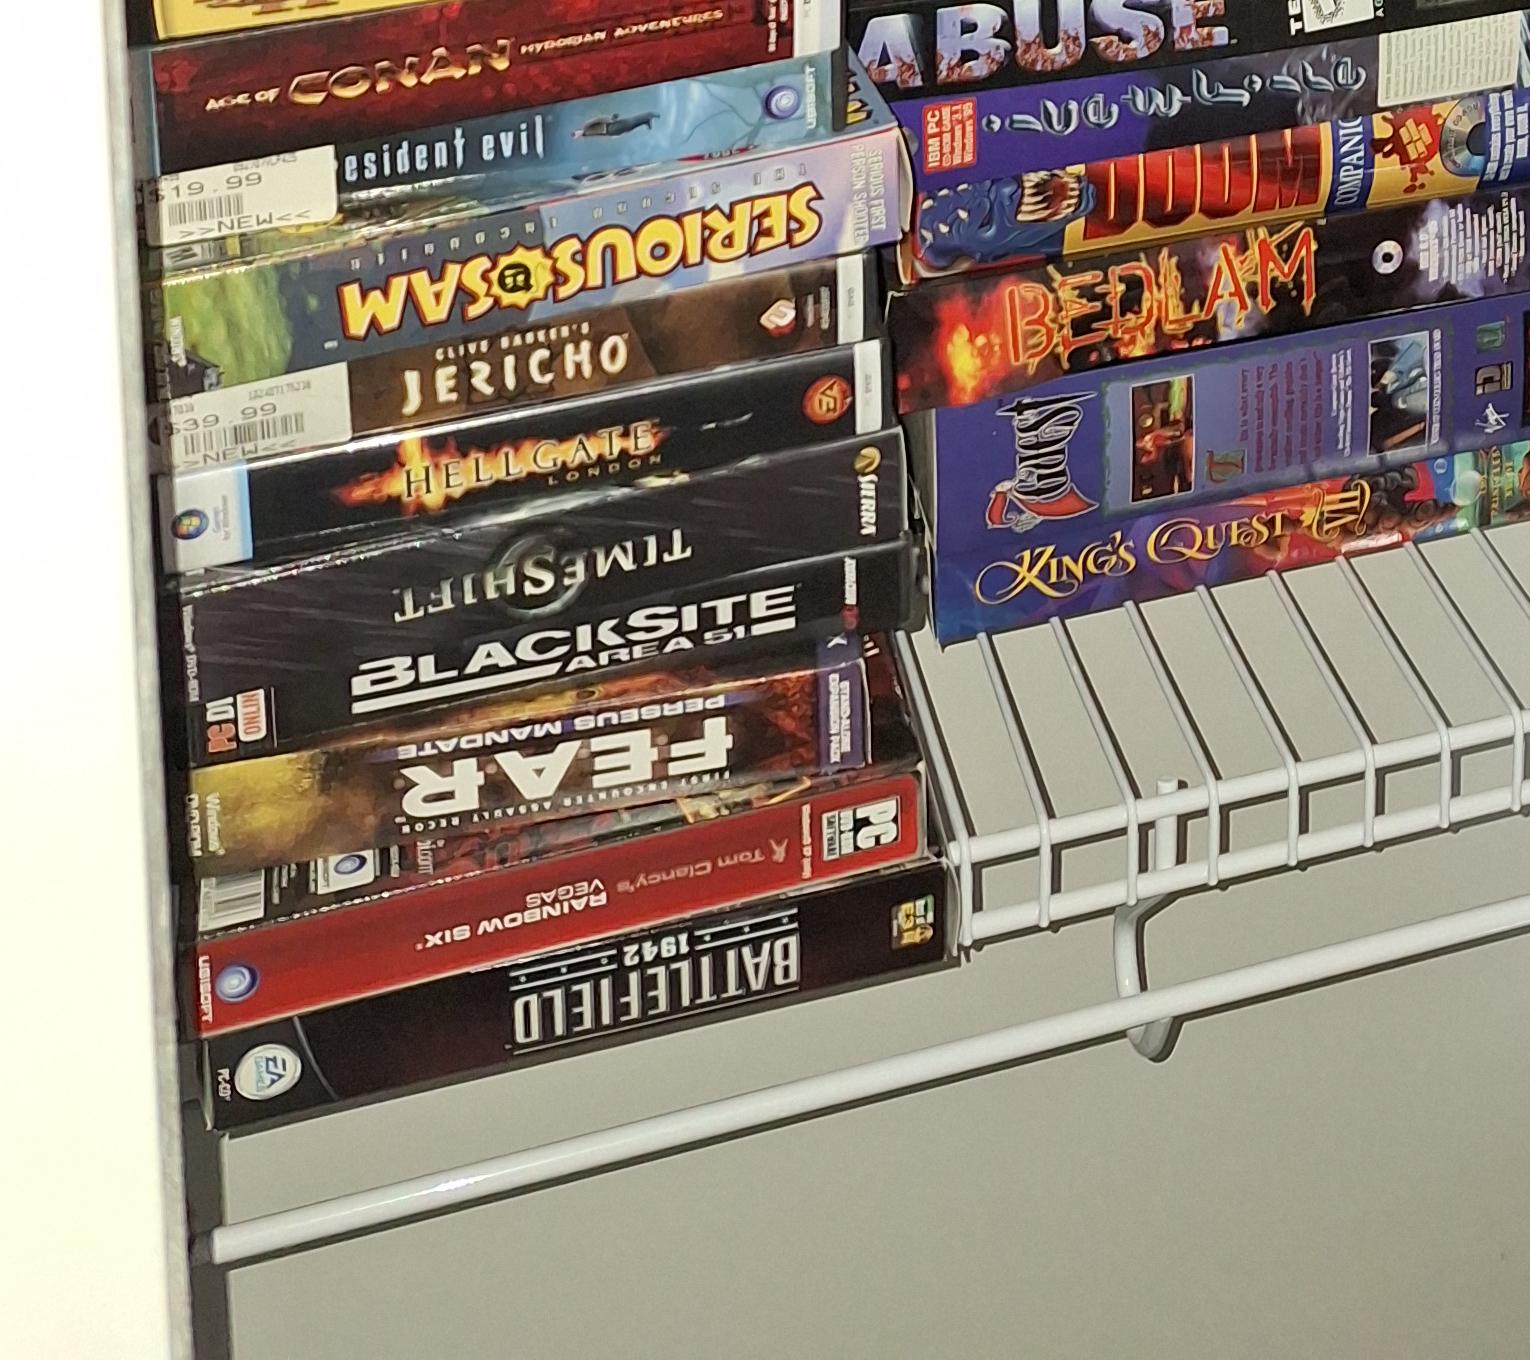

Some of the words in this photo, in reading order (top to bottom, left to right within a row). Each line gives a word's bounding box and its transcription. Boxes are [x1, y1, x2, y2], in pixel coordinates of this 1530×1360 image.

[541, 181, 824, 283] SERIOUS
[337, 265, 496, 330] SAM
[1003, 227, 1319, 364] BEDLAM
[401, 333, 629, 417] JERICHO
[402, 421, 656, 501] HELLGATE
[393, 527, 694, 624] TIMESHIFT
[975, 532, 1137, 606] KING'S
[1147, 510, 1285, 565] QUEST
[350, 584, 798, 696] BLACKSITE
[395, 725, 562, 758] MANDATE
[573, 697, 726, 730] PERSEUS
[422, 927, 471, 950] SIX
[476, 890, 609, 935] RAINBOW
[511, 934, 800, 1046] BATTLEFIELD
